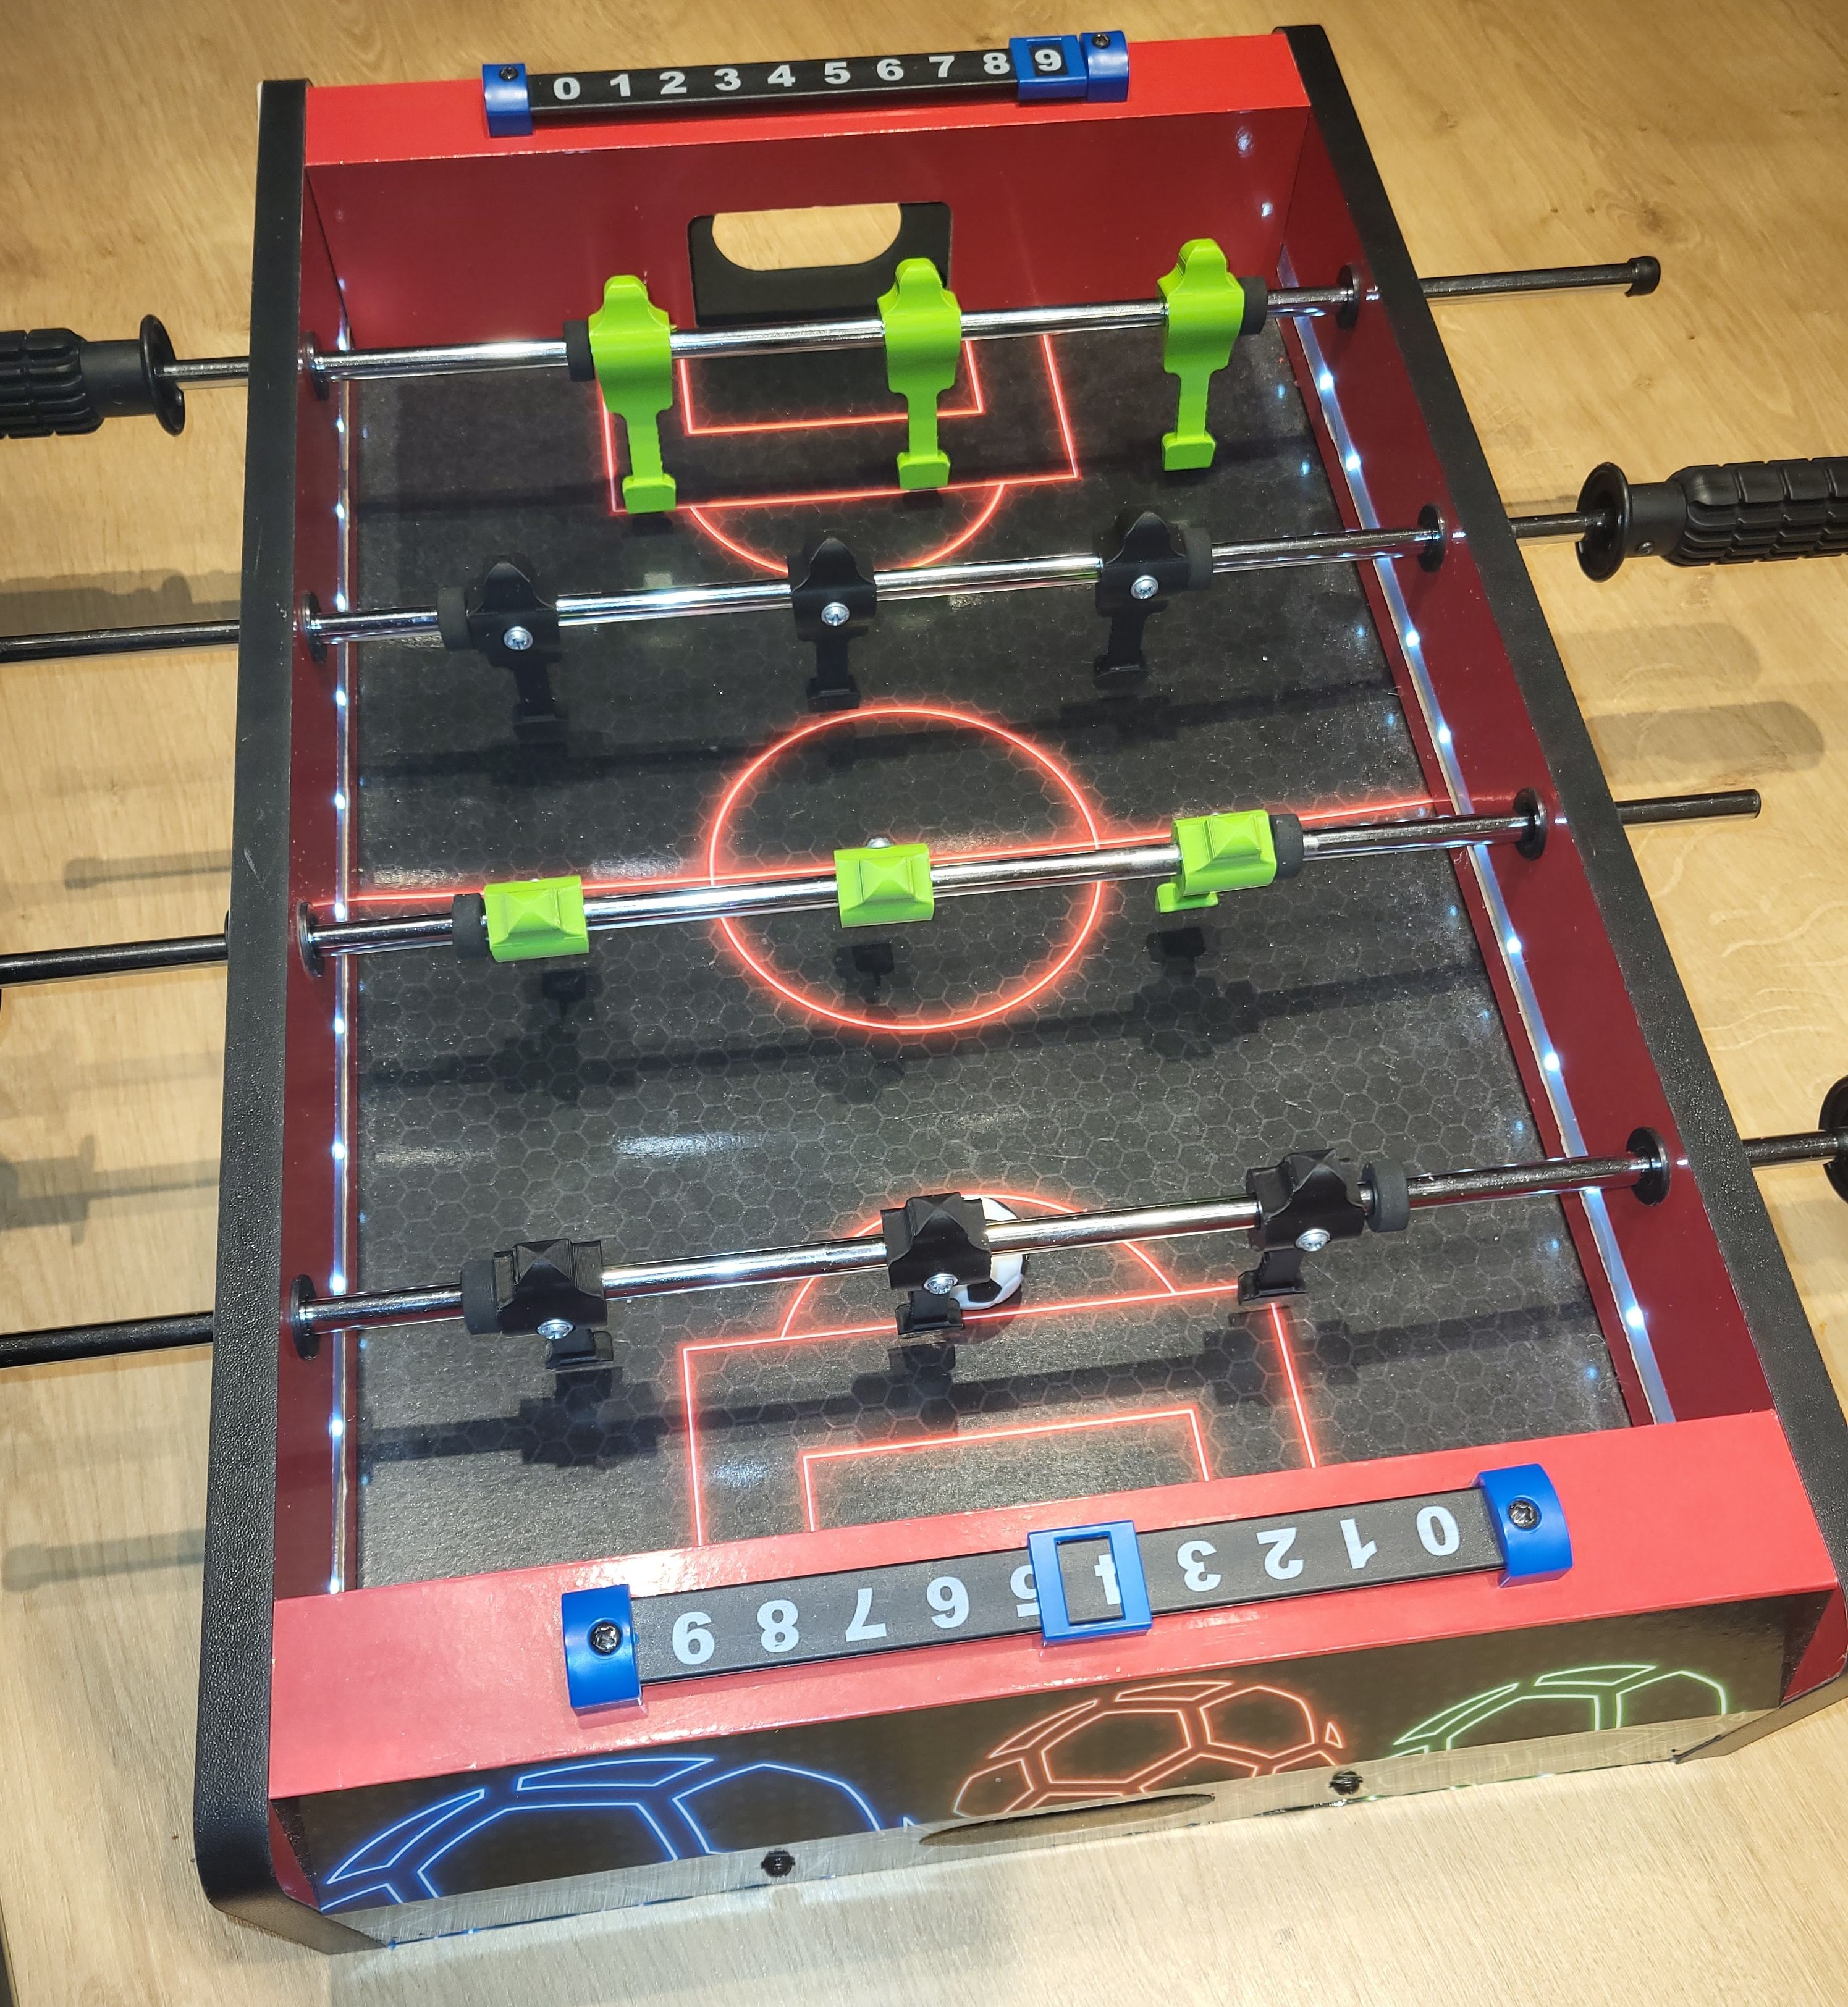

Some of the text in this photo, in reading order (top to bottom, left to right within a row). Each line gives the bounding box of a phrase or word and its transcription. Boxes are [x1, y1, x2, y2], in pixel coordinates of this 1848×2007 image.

[554, 49, 1061, 99] 0 1 2 3 4 5 6 7 8 9
[1256, 1527, 1304, 1580] 2
[1340, 1518, 1378, 1570] 1
[1416, 1505, 1460, 1557] 0
[1176, 1541, 1221, 1592] 3
[757, 1599, 800, 1653] 8
[845, 1588, 887, 1642] 7
[927, 1576, 969, 1629] 6
[672, 1611, 715, 1665] 9
